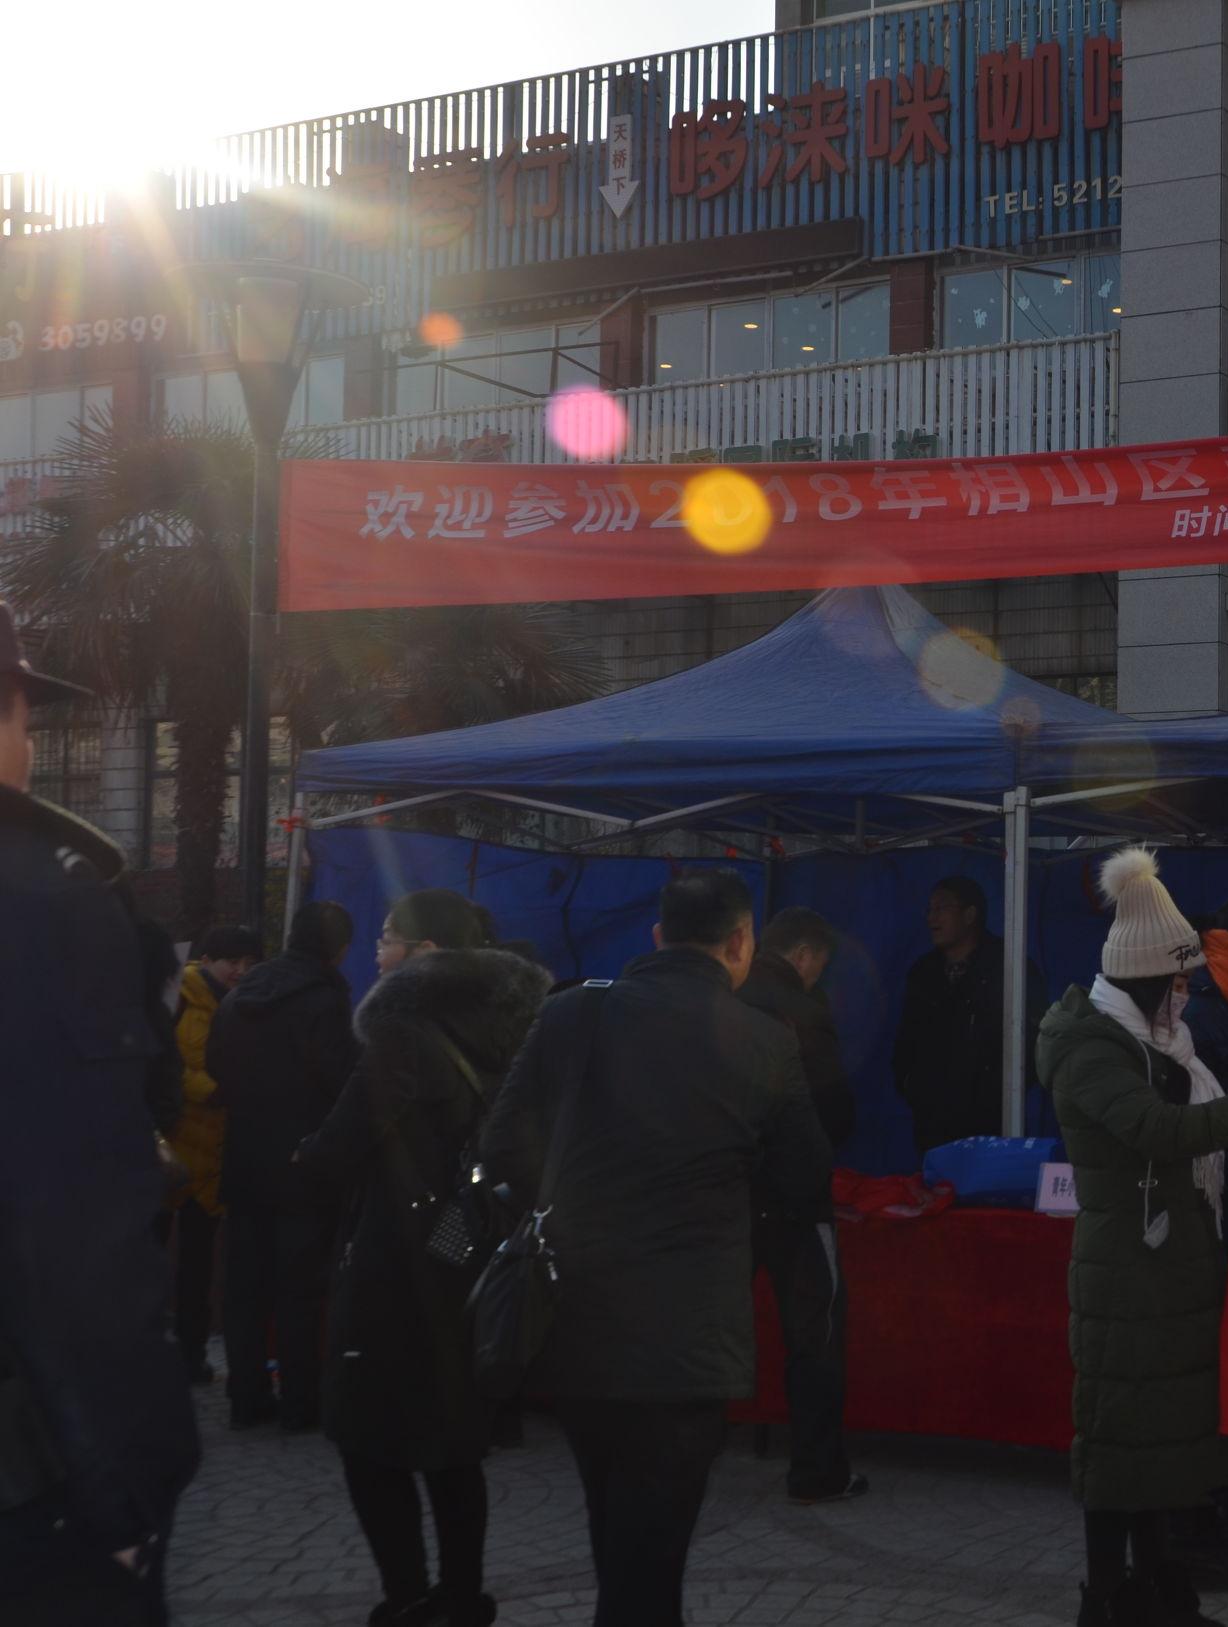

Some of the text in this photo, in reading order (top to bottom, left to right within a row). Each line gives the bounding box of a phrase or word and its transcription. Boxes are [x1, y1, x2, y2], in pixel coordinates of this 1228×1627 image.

[612, 123, 627, 196] 天桥下
[37, 313, 167, 352] 3059899
